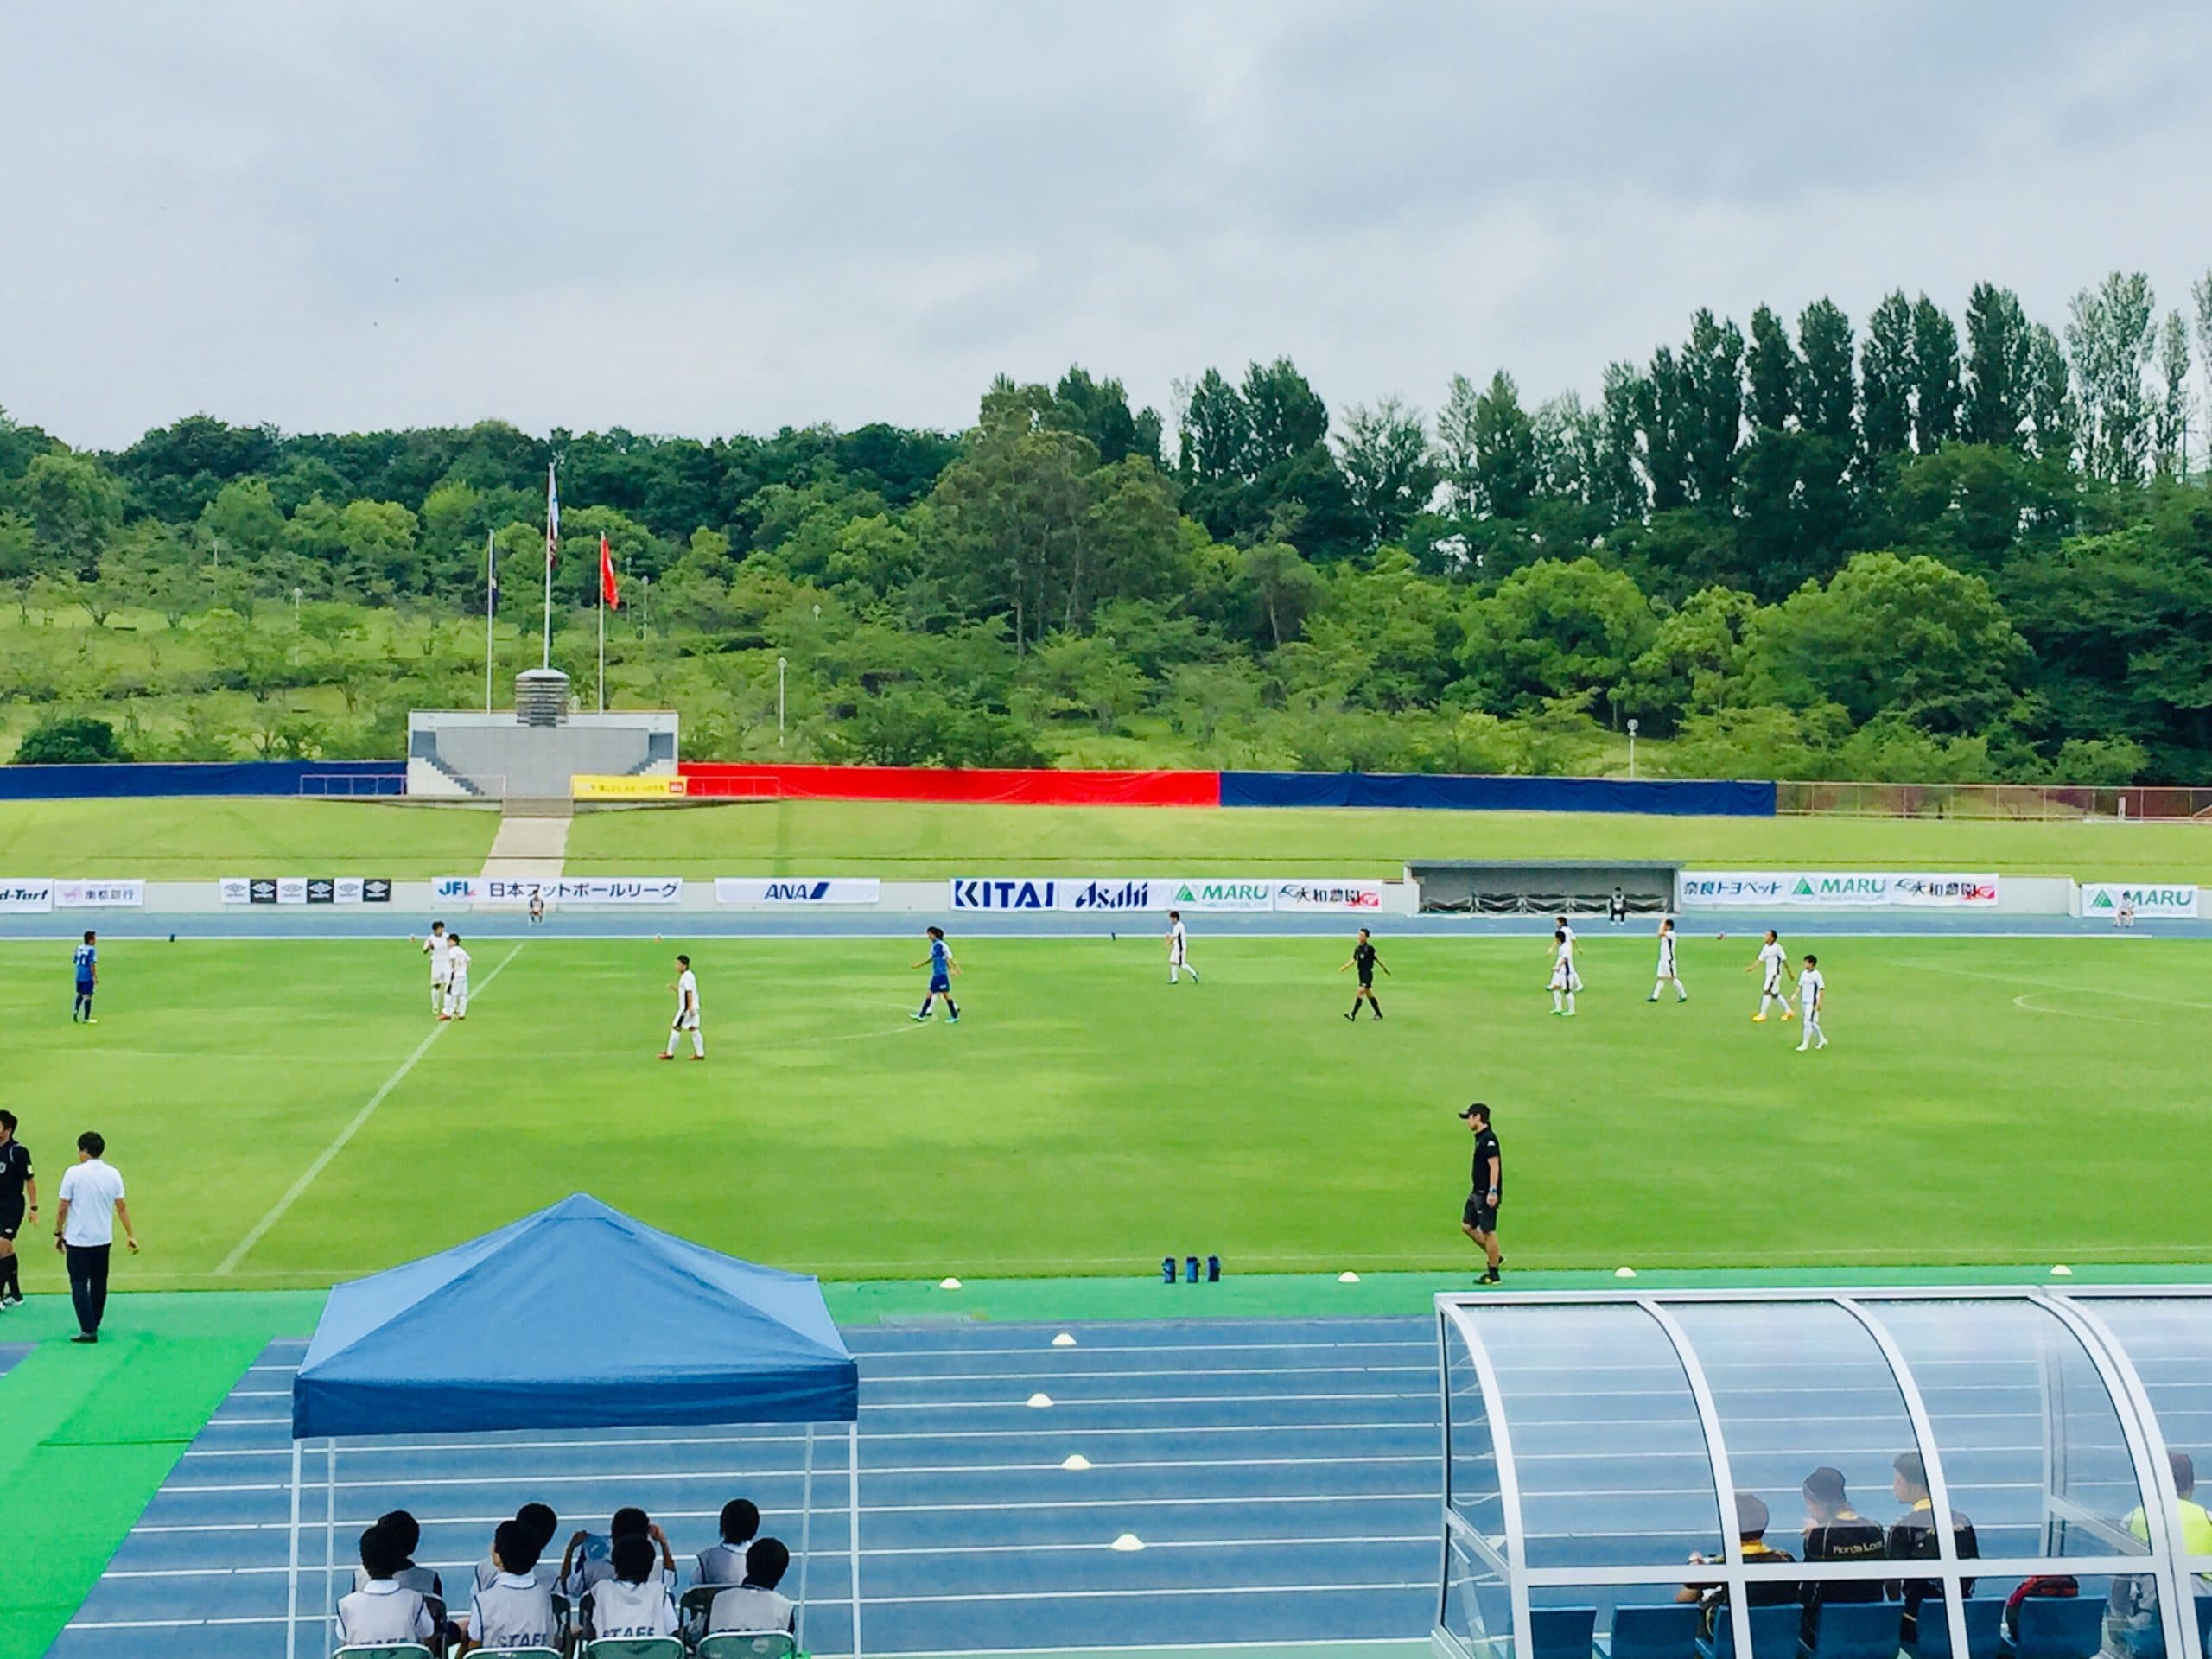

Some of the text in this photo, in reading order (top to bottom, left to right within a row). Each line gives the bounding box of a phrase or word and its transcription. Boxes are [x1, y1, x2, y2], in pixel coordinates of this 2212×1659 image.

[439, 881, 678, 897] JFL 日本フットボールリーグ
[765, 883, 811, 900] ANA
[955, 880, 1053, 907] KITAI
[1202, 884, 1269, 900] MARU
[1684, 881, 1783, 895] 奈良トヨペット
[1820, 878, 1887, 893] MARU
[85, 889, 134, 900] 南都銀行
[1076, 881, 1148, 908] Asahi
[1295, 887, 1361, 904] 大和農園
[2129, 890, 2193, 906] MARU
